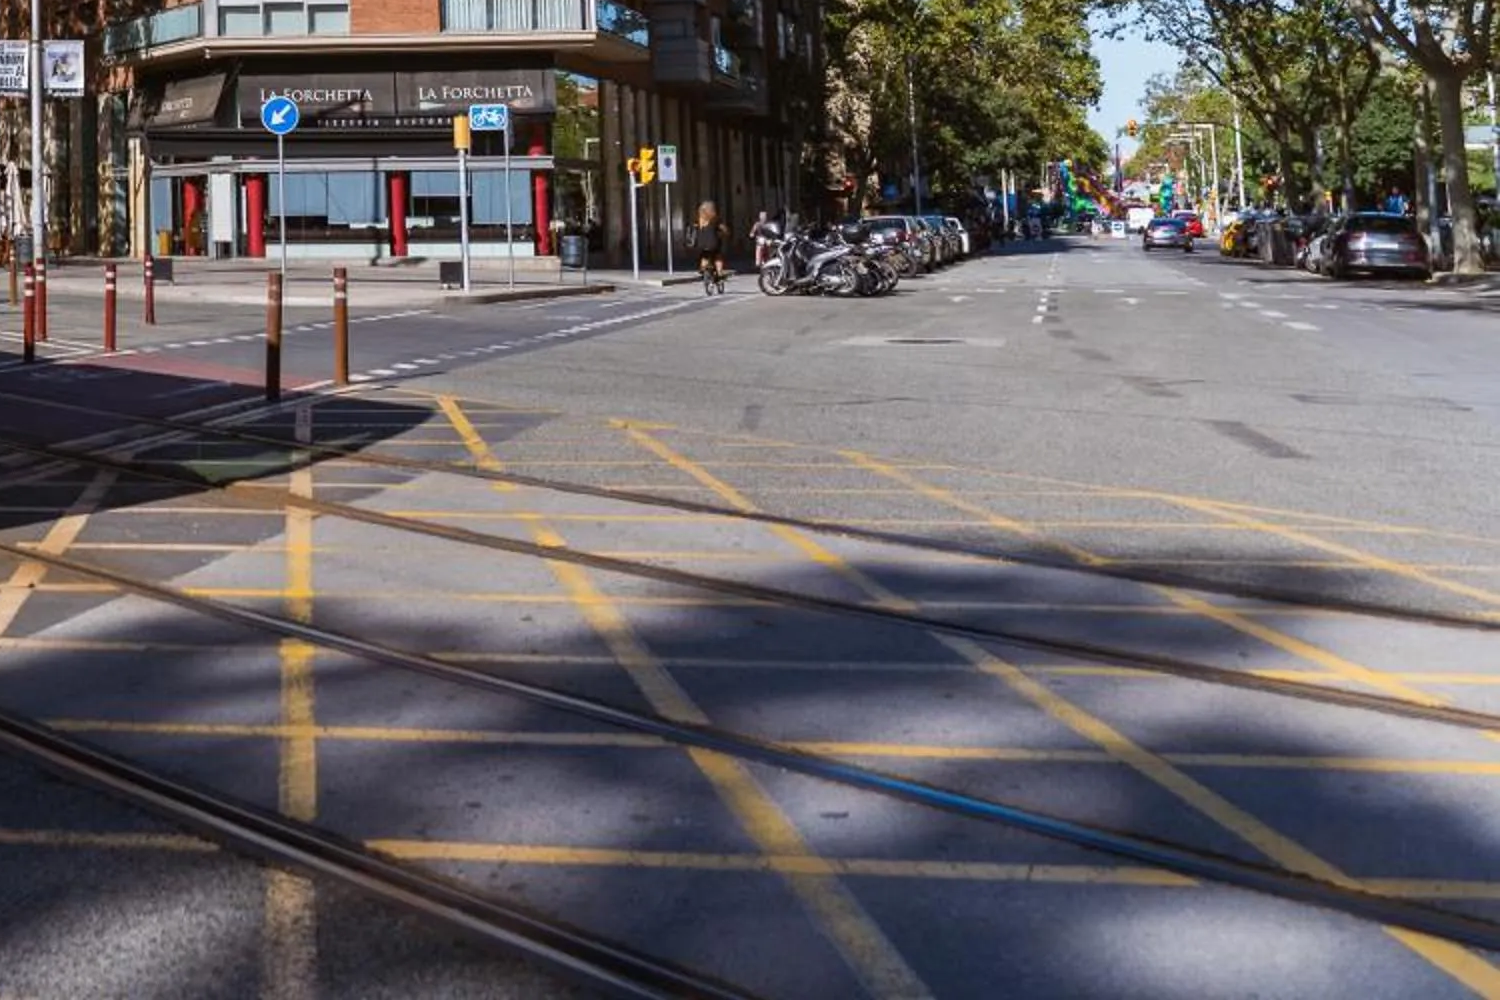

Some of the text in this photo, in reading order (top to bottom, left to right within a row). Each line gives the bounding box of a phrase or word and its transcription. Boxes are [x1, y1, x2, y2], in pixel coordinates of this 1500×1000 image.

[283, 87, 373, 101] FORCHETTA
[419, 85, 533, 100] LA FORCHETTA
